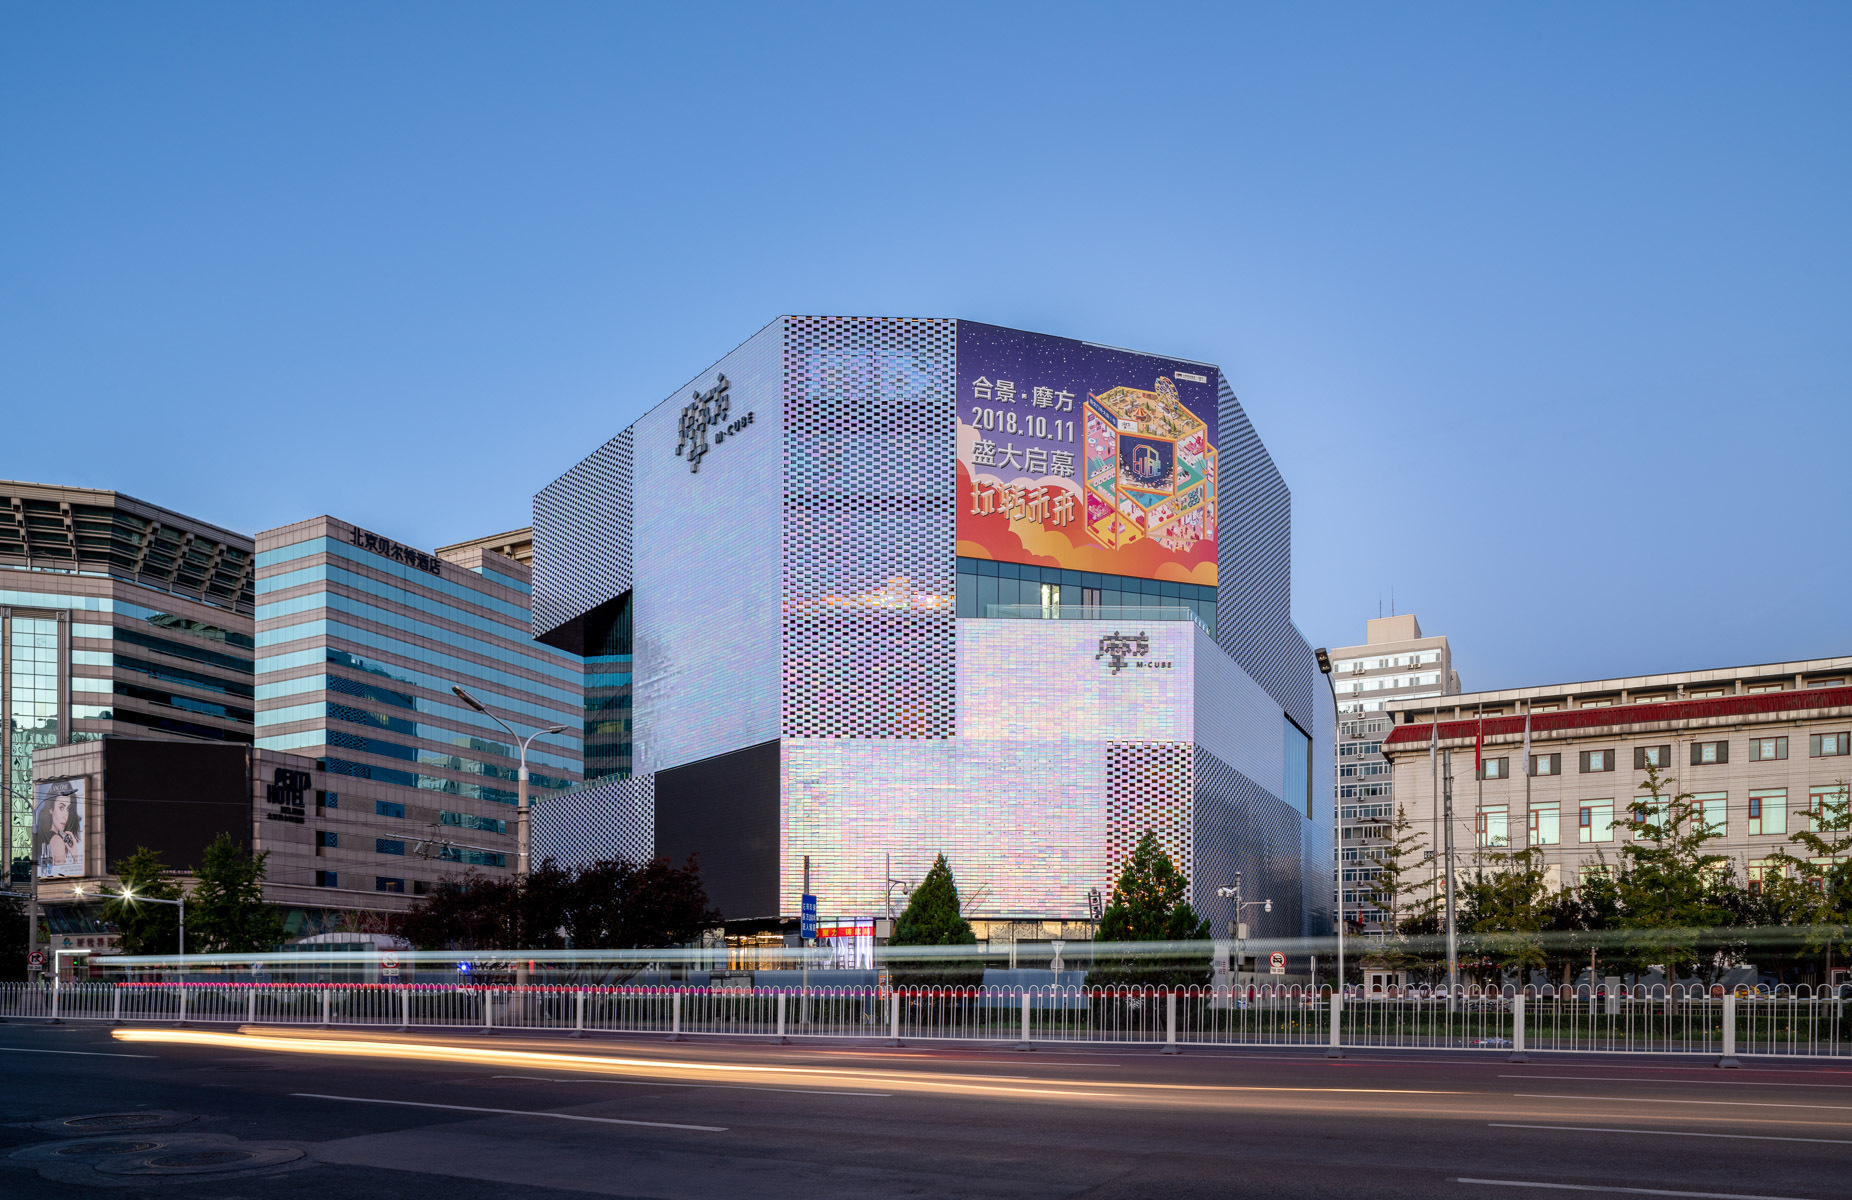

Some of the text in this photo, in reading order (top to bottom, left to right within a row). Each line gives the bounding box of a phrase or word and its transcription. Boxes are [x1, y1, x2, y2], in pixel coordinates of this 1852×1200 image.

[972, 376, 1075, 412] 合景·摩方
[972, 407, 1074, 443] 2018.10.11
[971, 438, 1075, 478] 盛大启幕
[971, 478, 1075, 527] 玩转未来
[349, 526, 442, 575] 北京贝尔特酒店
[266, 784, 305, 808] HOTEL
